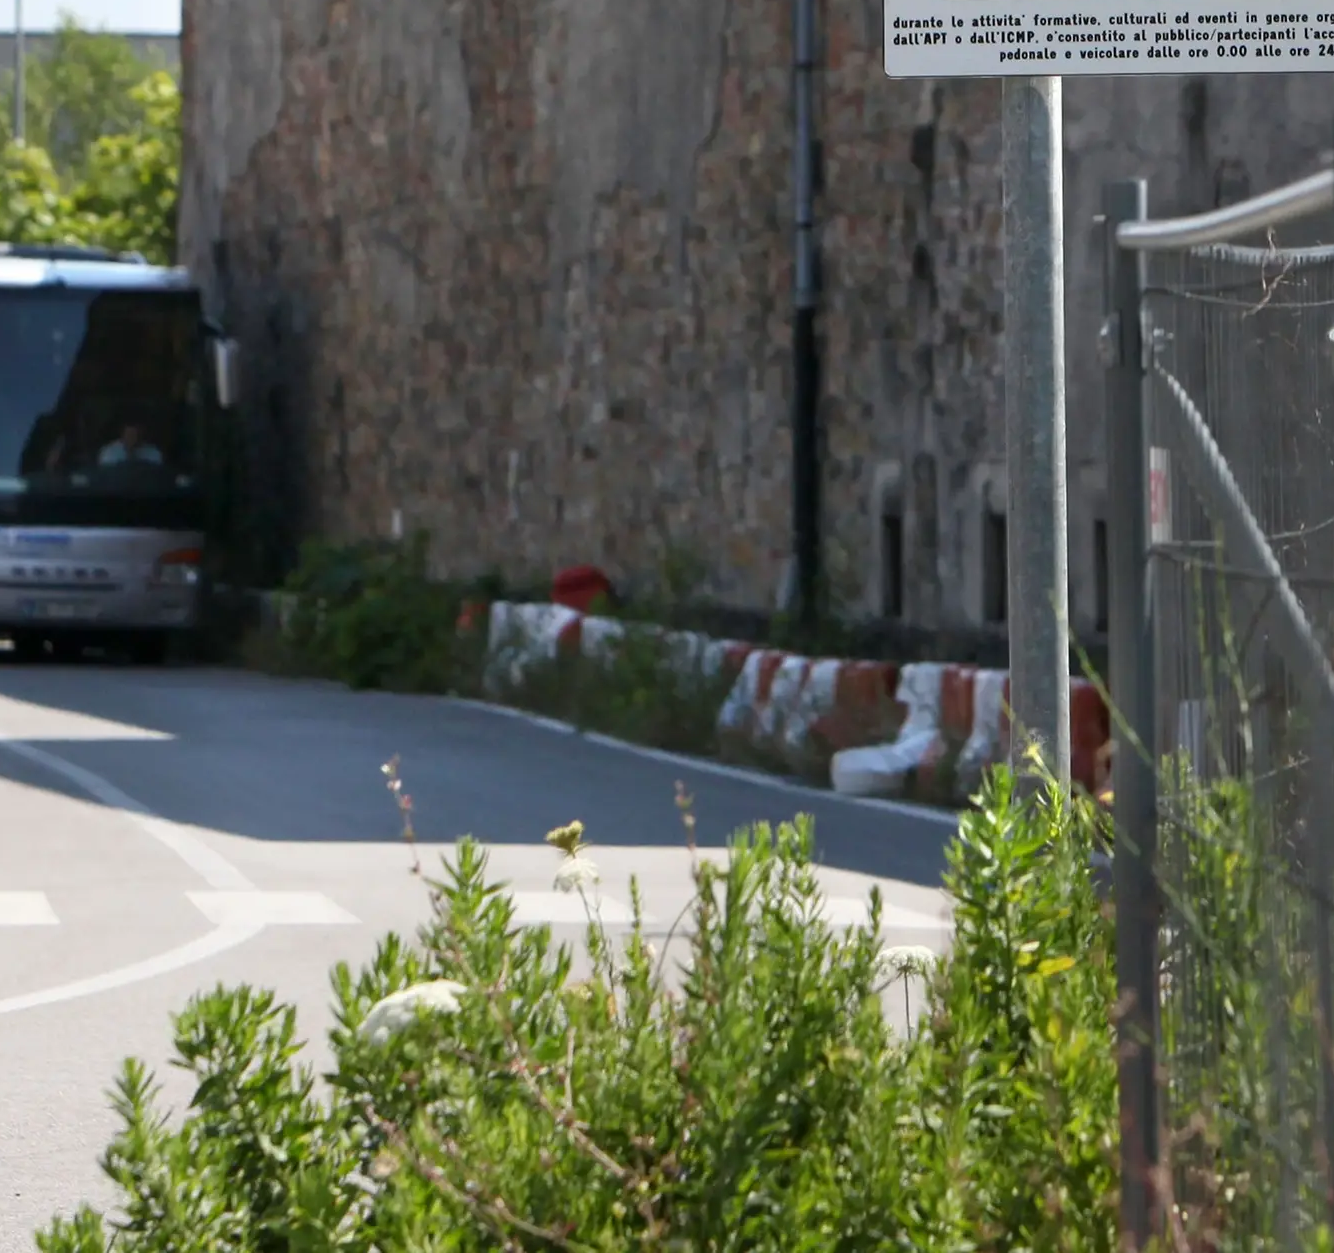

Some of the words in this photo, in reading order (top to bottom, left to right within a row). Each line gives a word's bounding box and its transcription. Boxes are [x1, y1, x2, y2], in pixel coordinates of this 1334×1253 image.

[893, 16, 944, 29] durante
[951, 15, 964, 28] le
[1108, 12, 1167, 25] culturali
[1174, 11, 1190, 25] ed
[1197, 11, 1238, 24] eventi
[1245, 11, 1258, 24] in
[1265, 13, 1309, 26] genere
[1133, 29, 1147, 42] al
[999, 47, 1057, 63] pedonale
[1079, 46, 1140, 60] veicolare
[1146, 45, 1181, 59] dalle
[1188, 48, 1209, 58] ore
[1216, 44, 1248, 58] 0.00
[1255, 44, 1282, 57] alle
[1289, 47, 1310, 57] ore
